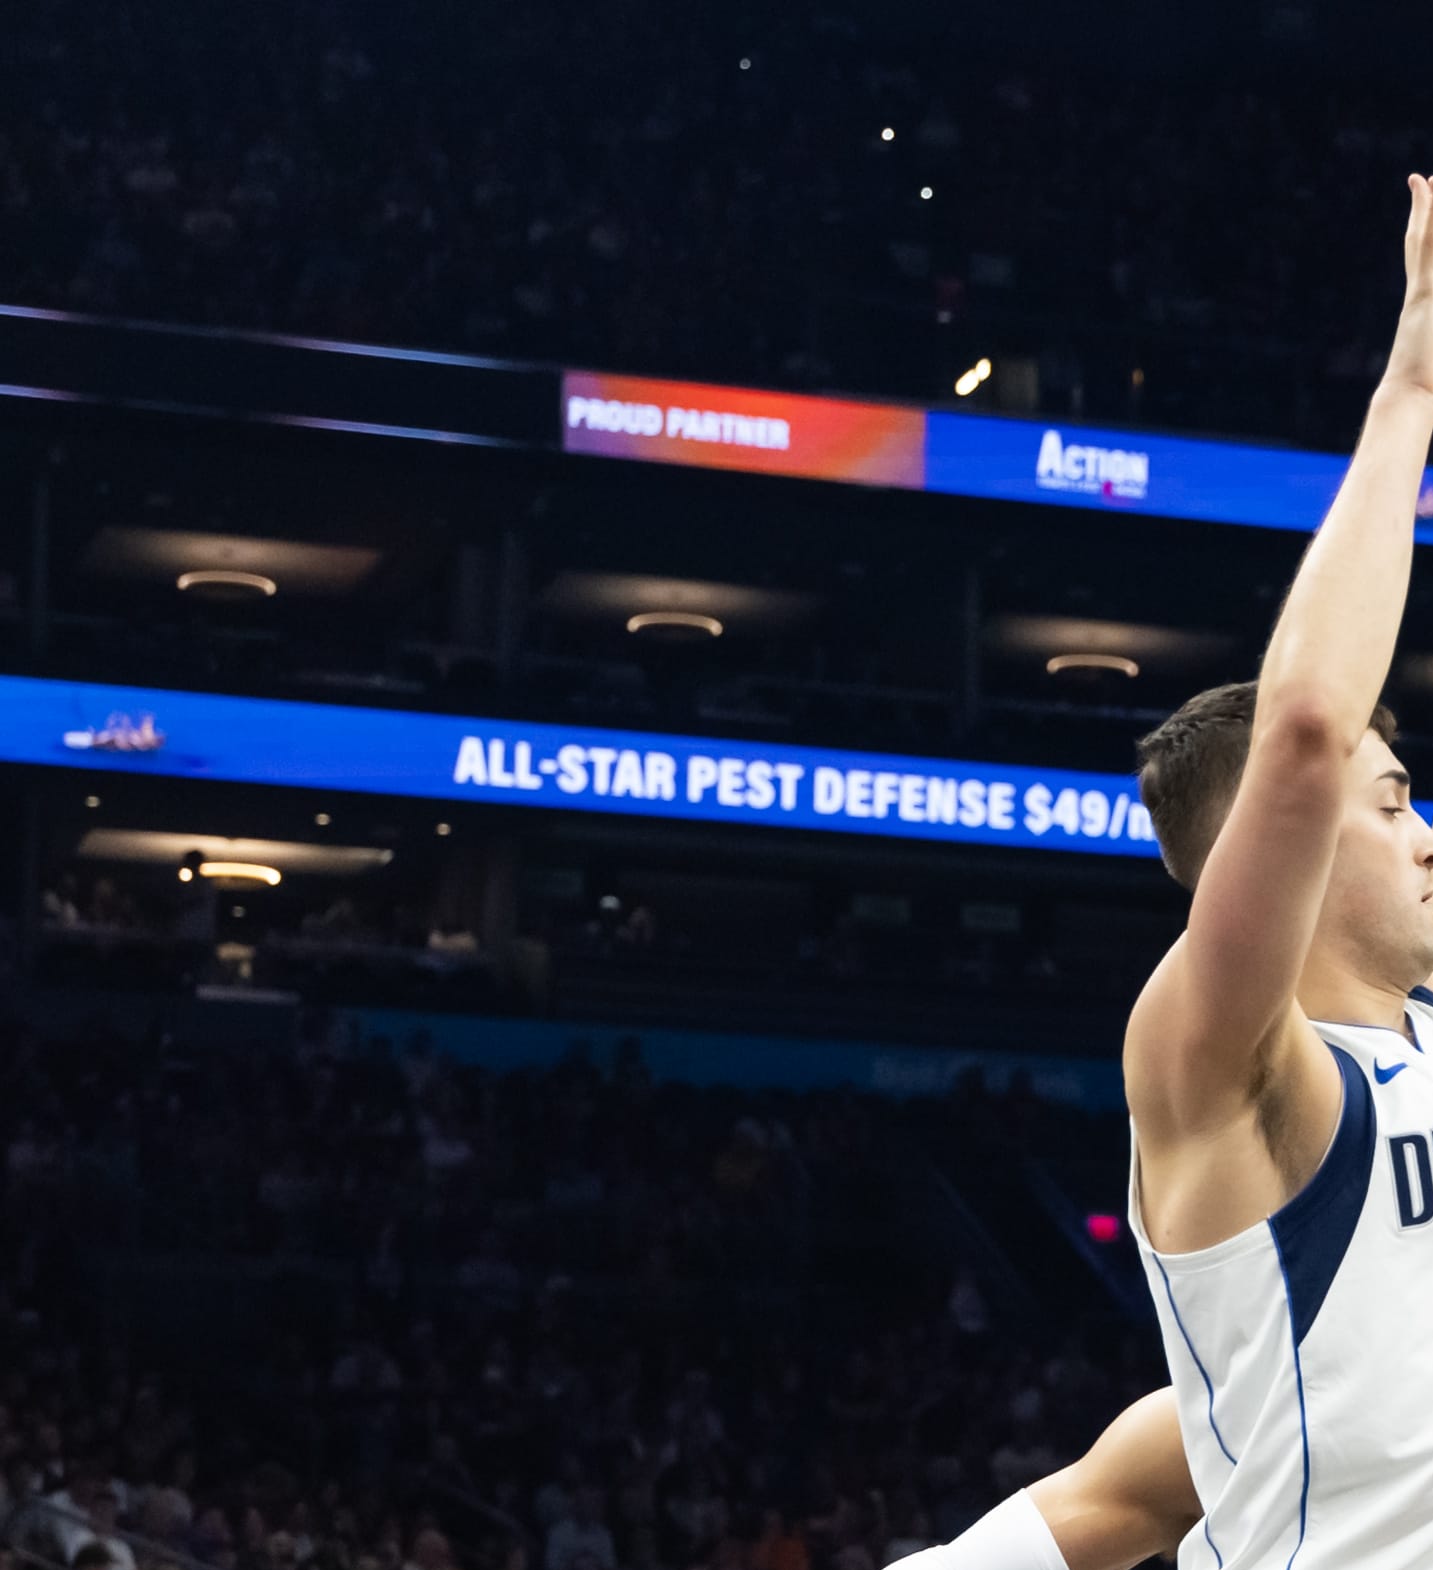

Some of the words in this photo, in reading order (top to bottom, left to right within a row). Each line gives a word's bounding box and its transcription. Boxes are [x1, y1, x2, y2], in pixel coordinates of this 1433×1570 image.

[567, 396, 661, 438] PROUD
[666, 404, 790, 450] PARTNER
[453, 734, 677, 802] ALL-STAR
[686, 754, 806, 812] PEST
[813, 766, 1017, 832] DEFENSE
[1023, 781, 1159, 842] $49/m
